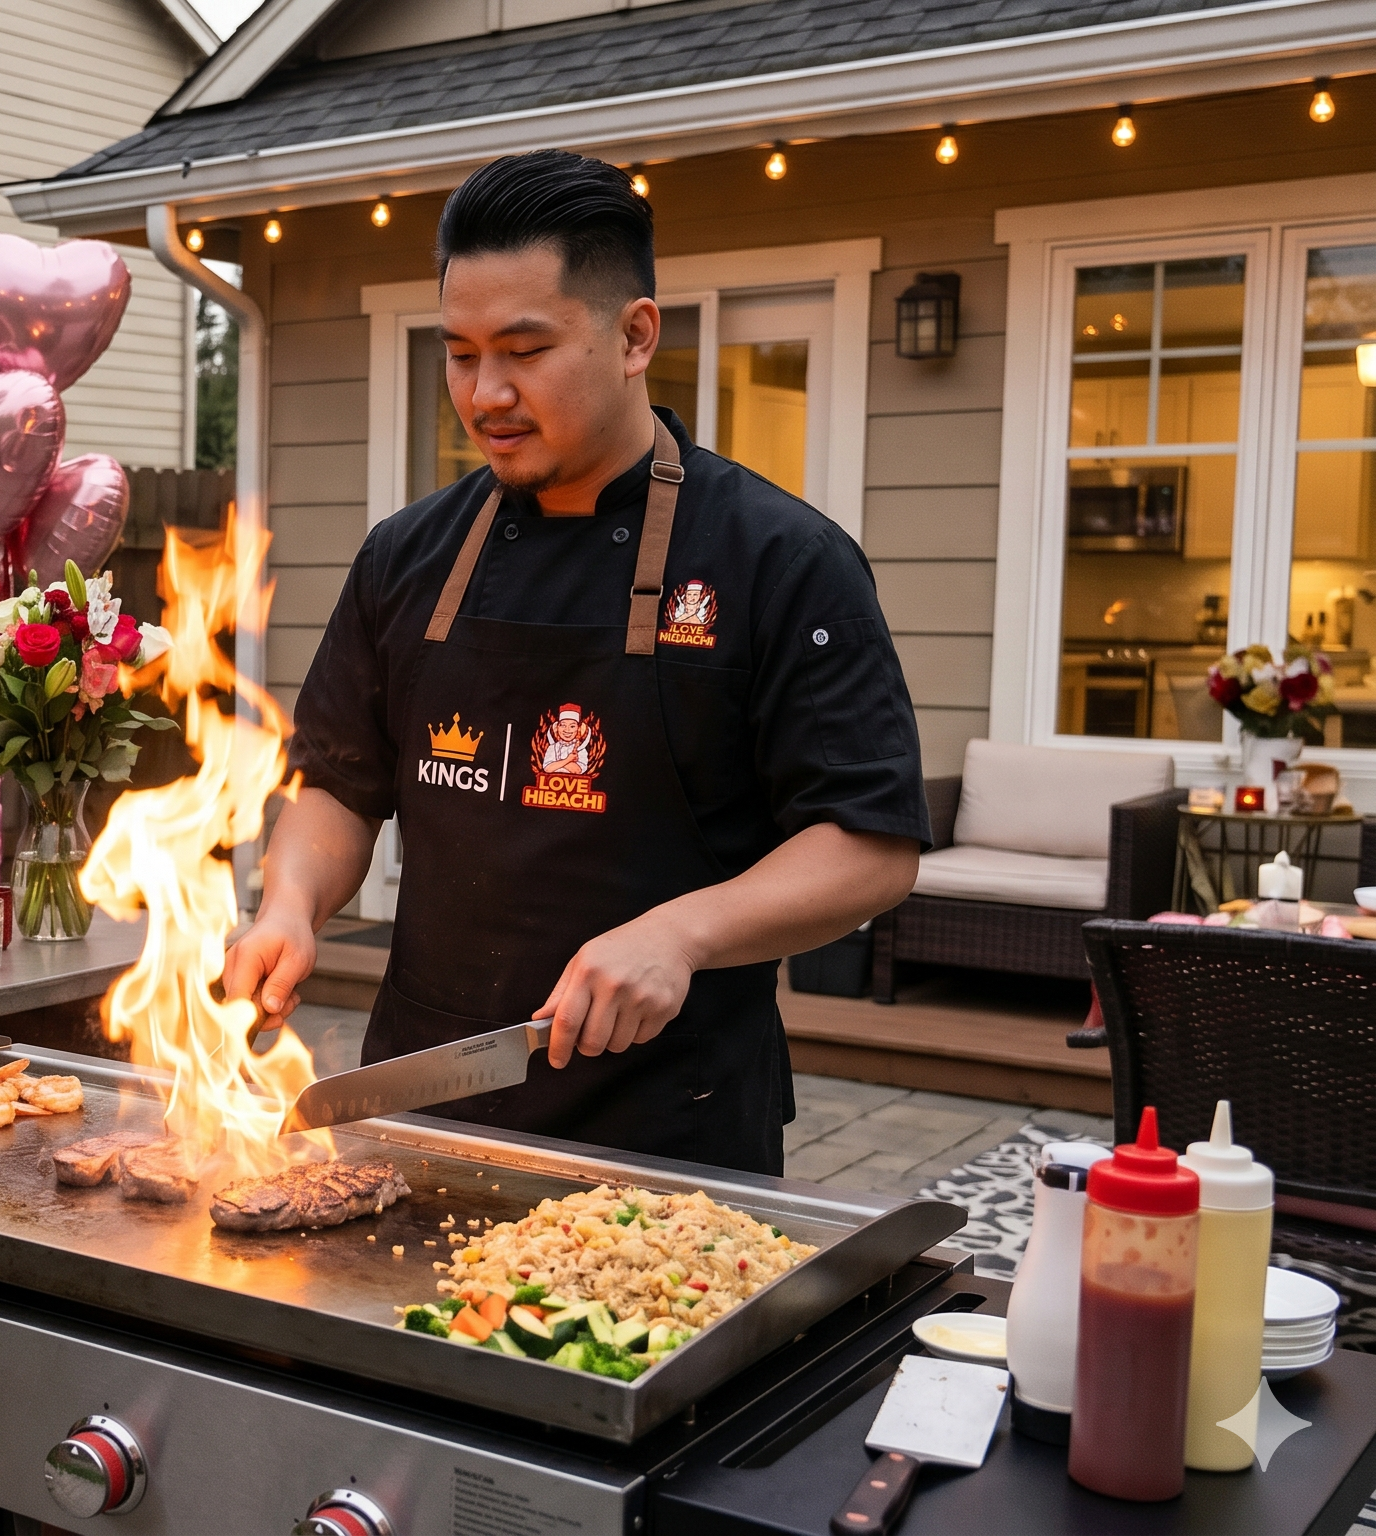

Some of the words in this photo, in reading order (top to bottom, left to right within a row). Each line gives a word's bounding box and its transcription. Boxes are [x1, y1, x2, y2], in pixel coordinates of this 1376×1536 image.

[418, 759, 489, 793] KINGS
[539, 776, 590, 793] LOVE
[524, 789, 603, 810] HIBACHI
